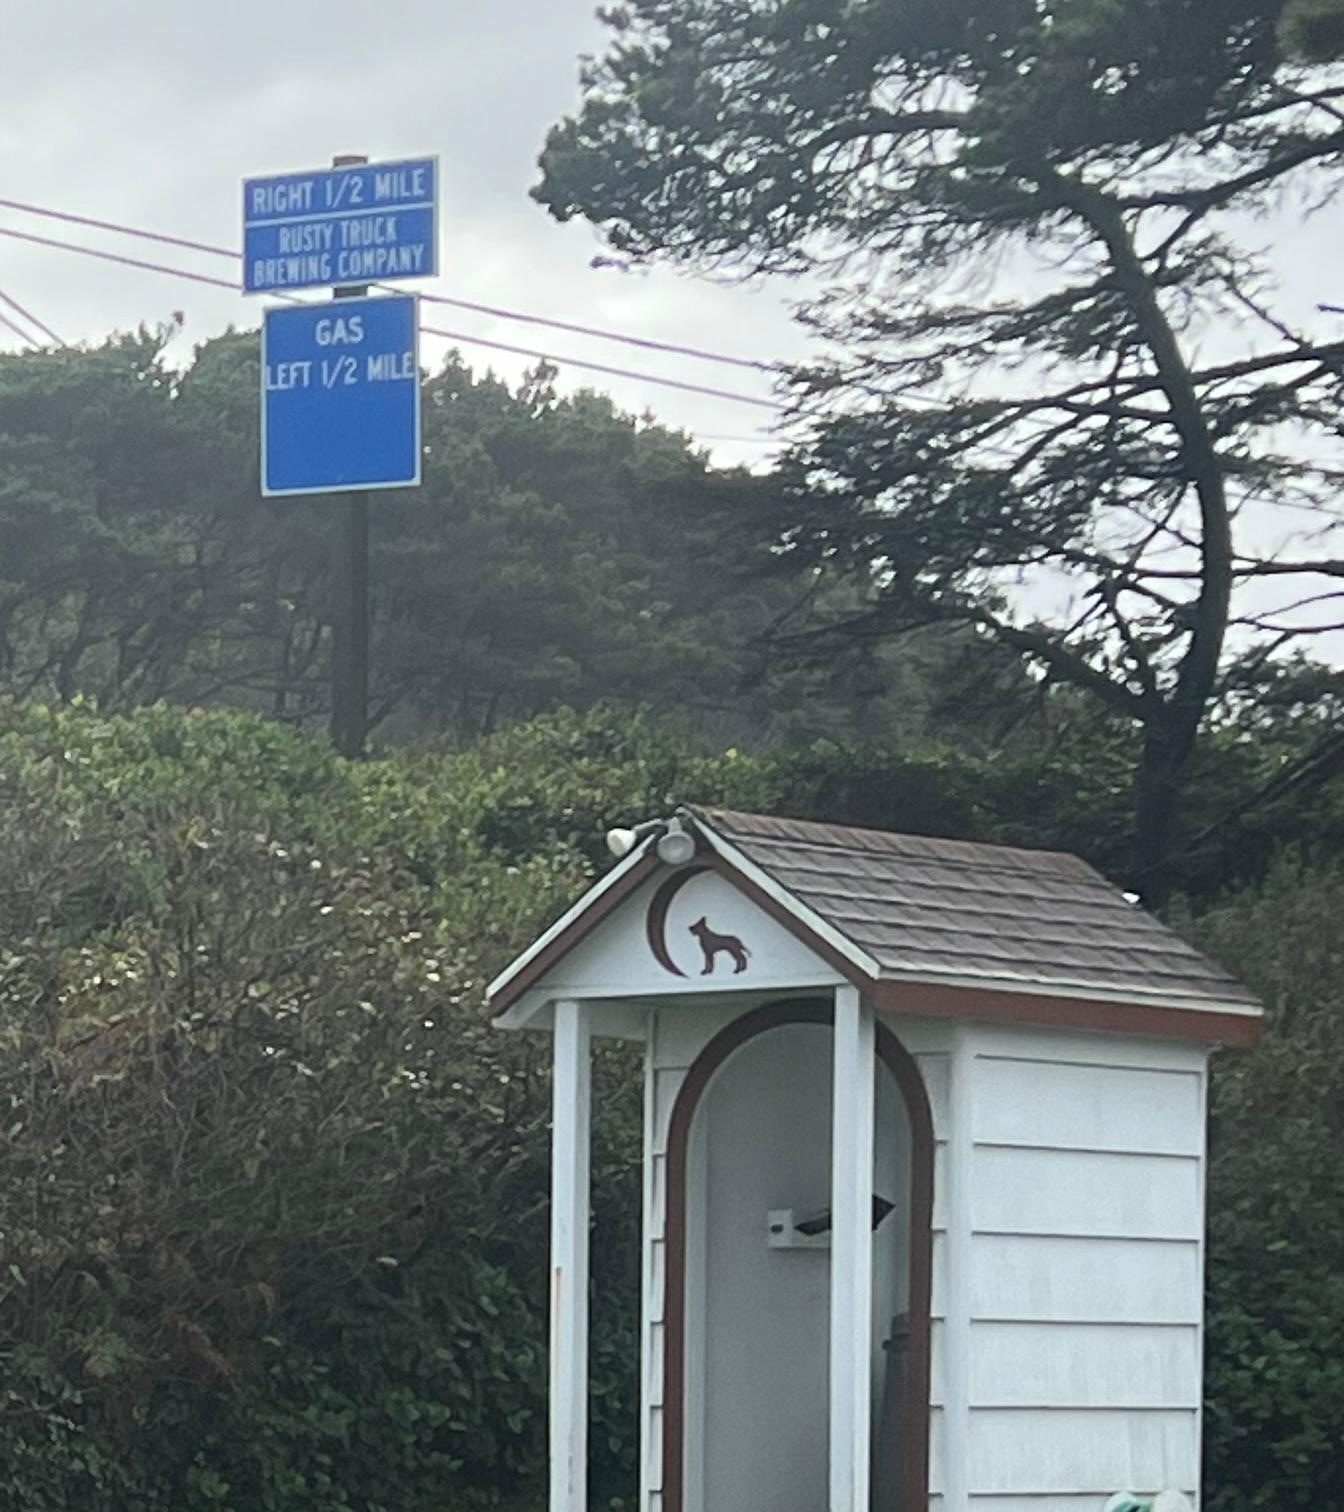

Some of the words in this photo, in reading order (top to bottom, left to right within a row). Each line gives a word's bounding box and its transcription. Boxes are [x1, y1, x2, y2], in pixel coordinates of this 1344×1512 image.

[253, 182, 313, 214] RIGHT
[325, 175, 363, 208] 1/2
[375, 168, 425, 200] MILE
[279, 223, 333, 254] RUSTY
[340, 217, 397, 246] TRUCK
[253, 253, 332, 287] BREWING
[338, 244, 425, 278] COMPANY
[315, 315, 364, 345] GAS
[267, 362, 312, 390] LEFT
[321, 355, 358, 389] 1/2
[367, 352, 414, 381] MILE
